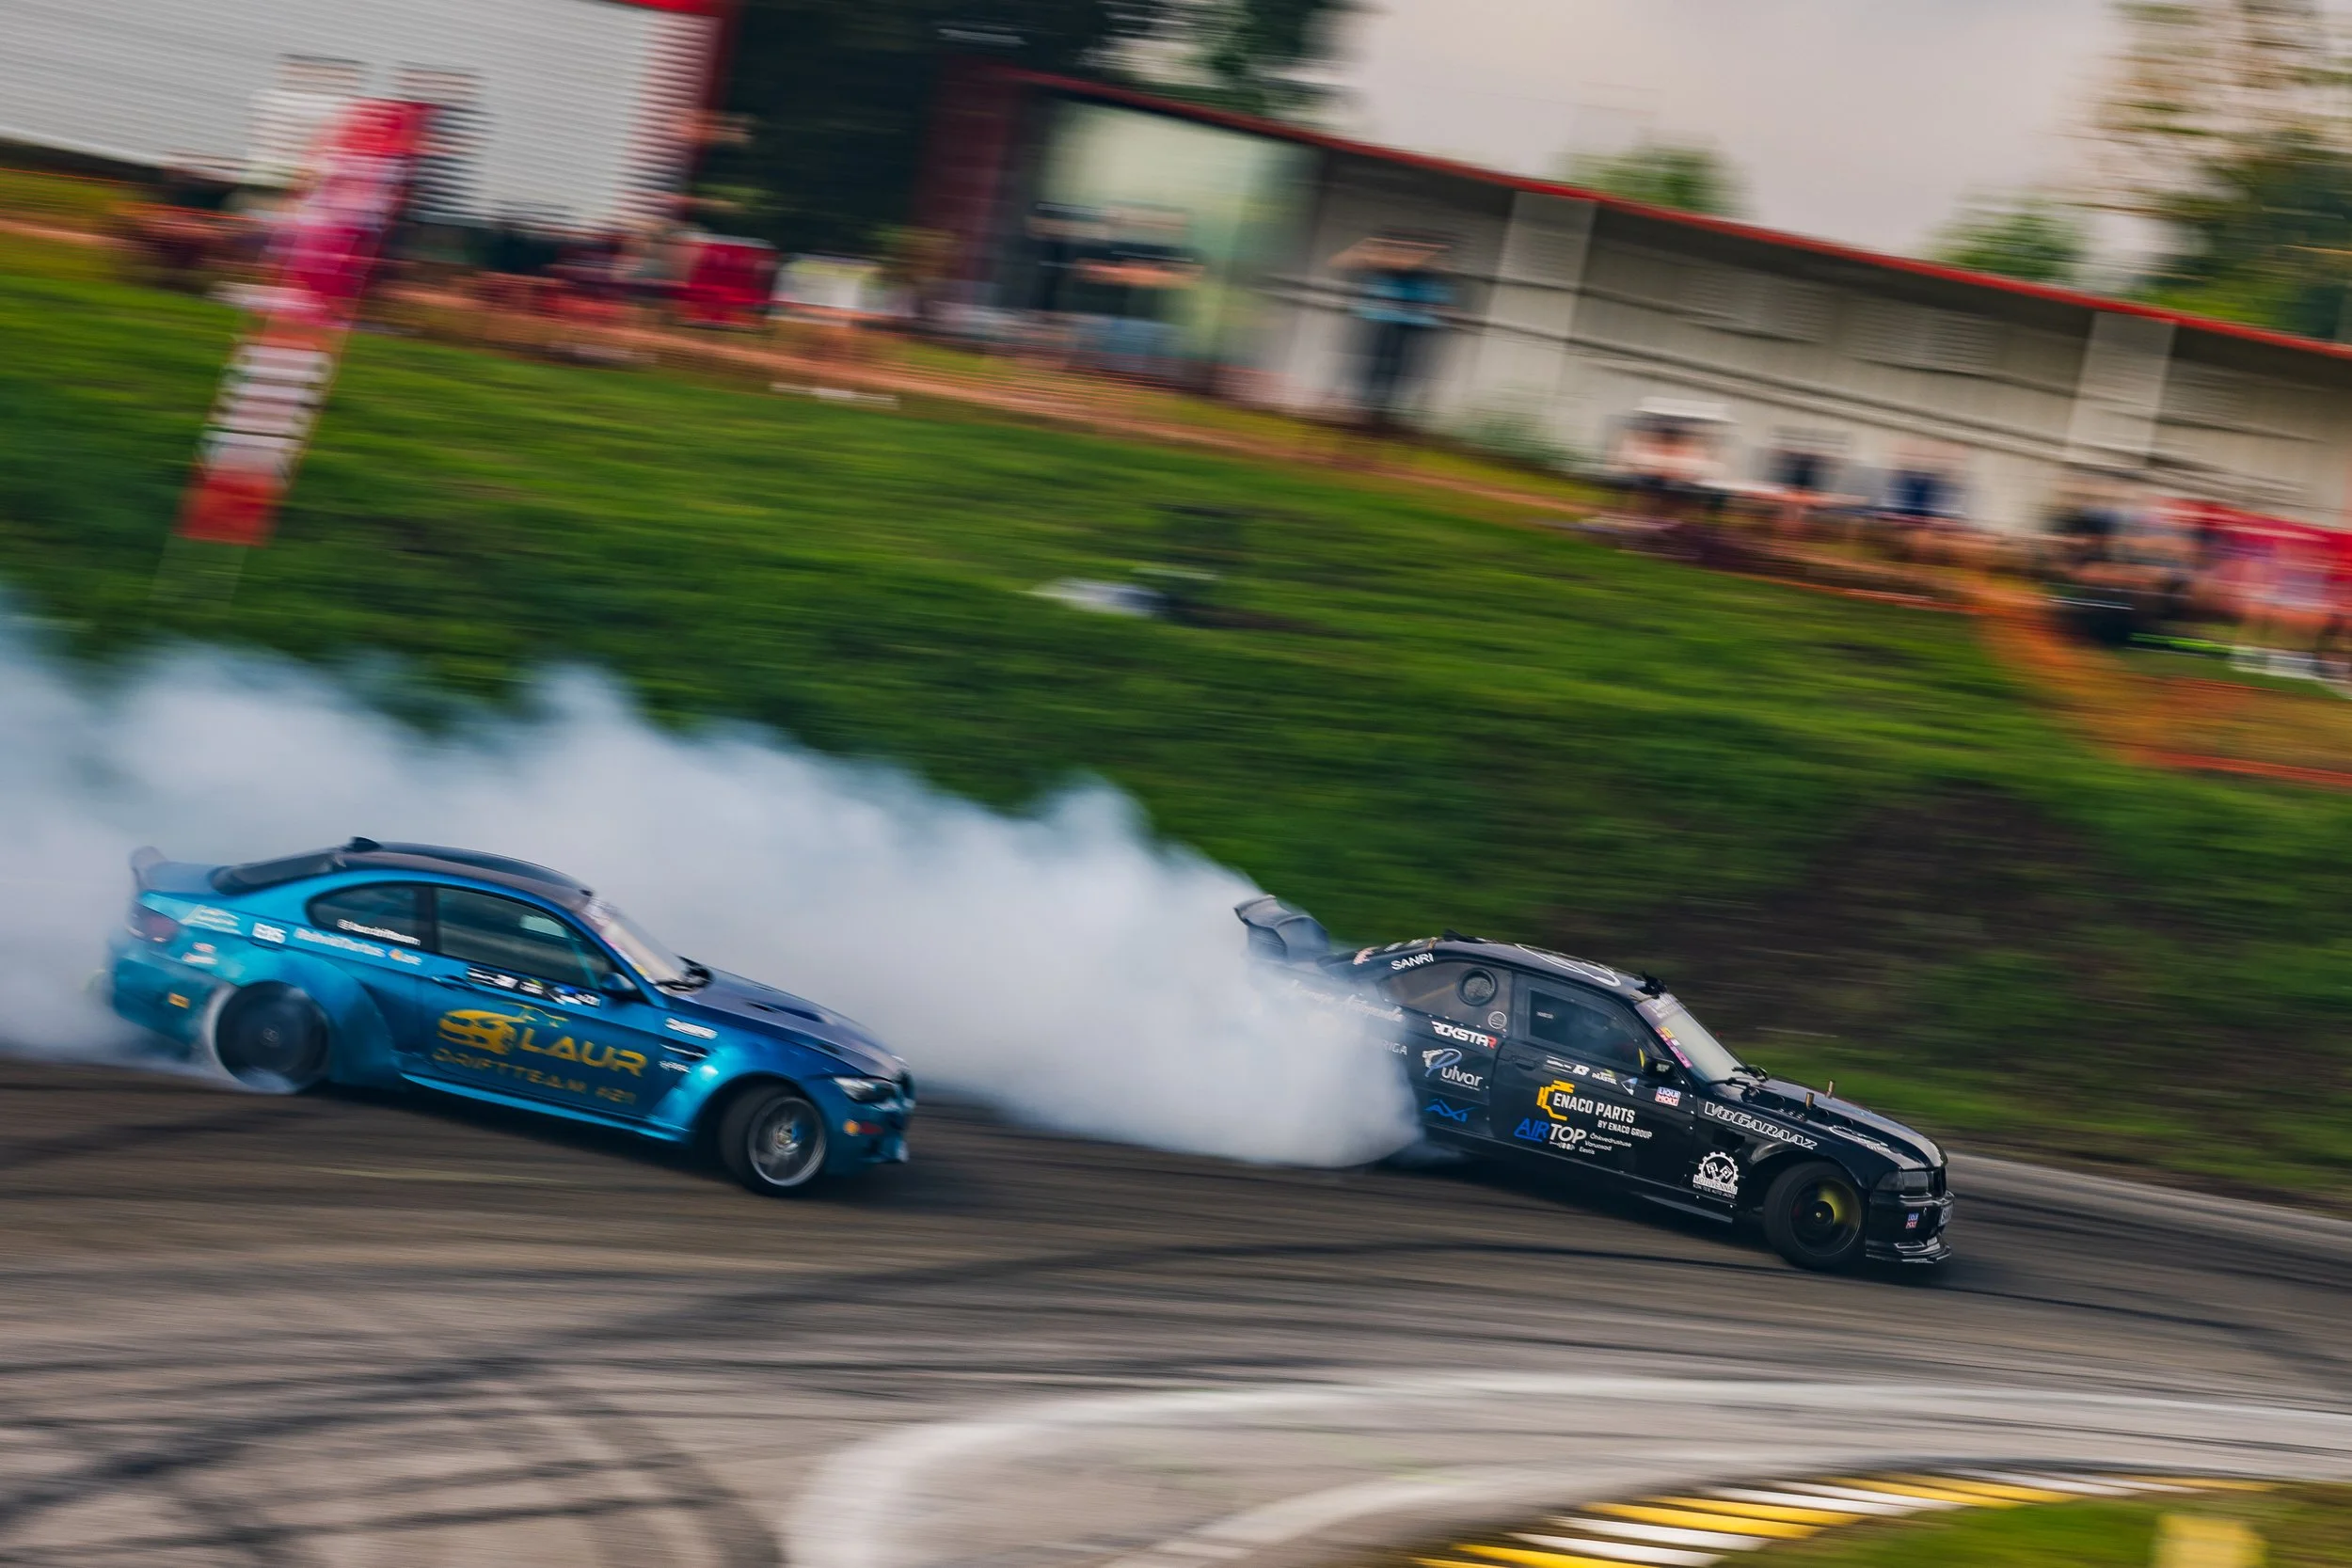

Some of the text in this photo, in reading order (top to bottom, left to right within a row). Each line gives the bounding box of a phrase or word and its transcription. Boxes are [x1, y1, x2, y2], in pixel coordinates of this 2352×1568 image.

[1391, 952, 1435, 971] SANRI
[519, 1027, 648, 1077] LAUR
[1424, 1048, 1484, 1087] Pulvar
[1655, 1095, 1680, 1107] MOLY
[1658, 1086, 1682, 1099] LIQUI
[1553, 1093, 1636, 1124] ENACO PARTS
[1597, 1119, 1653, 1140] BY ENACO GROUP
